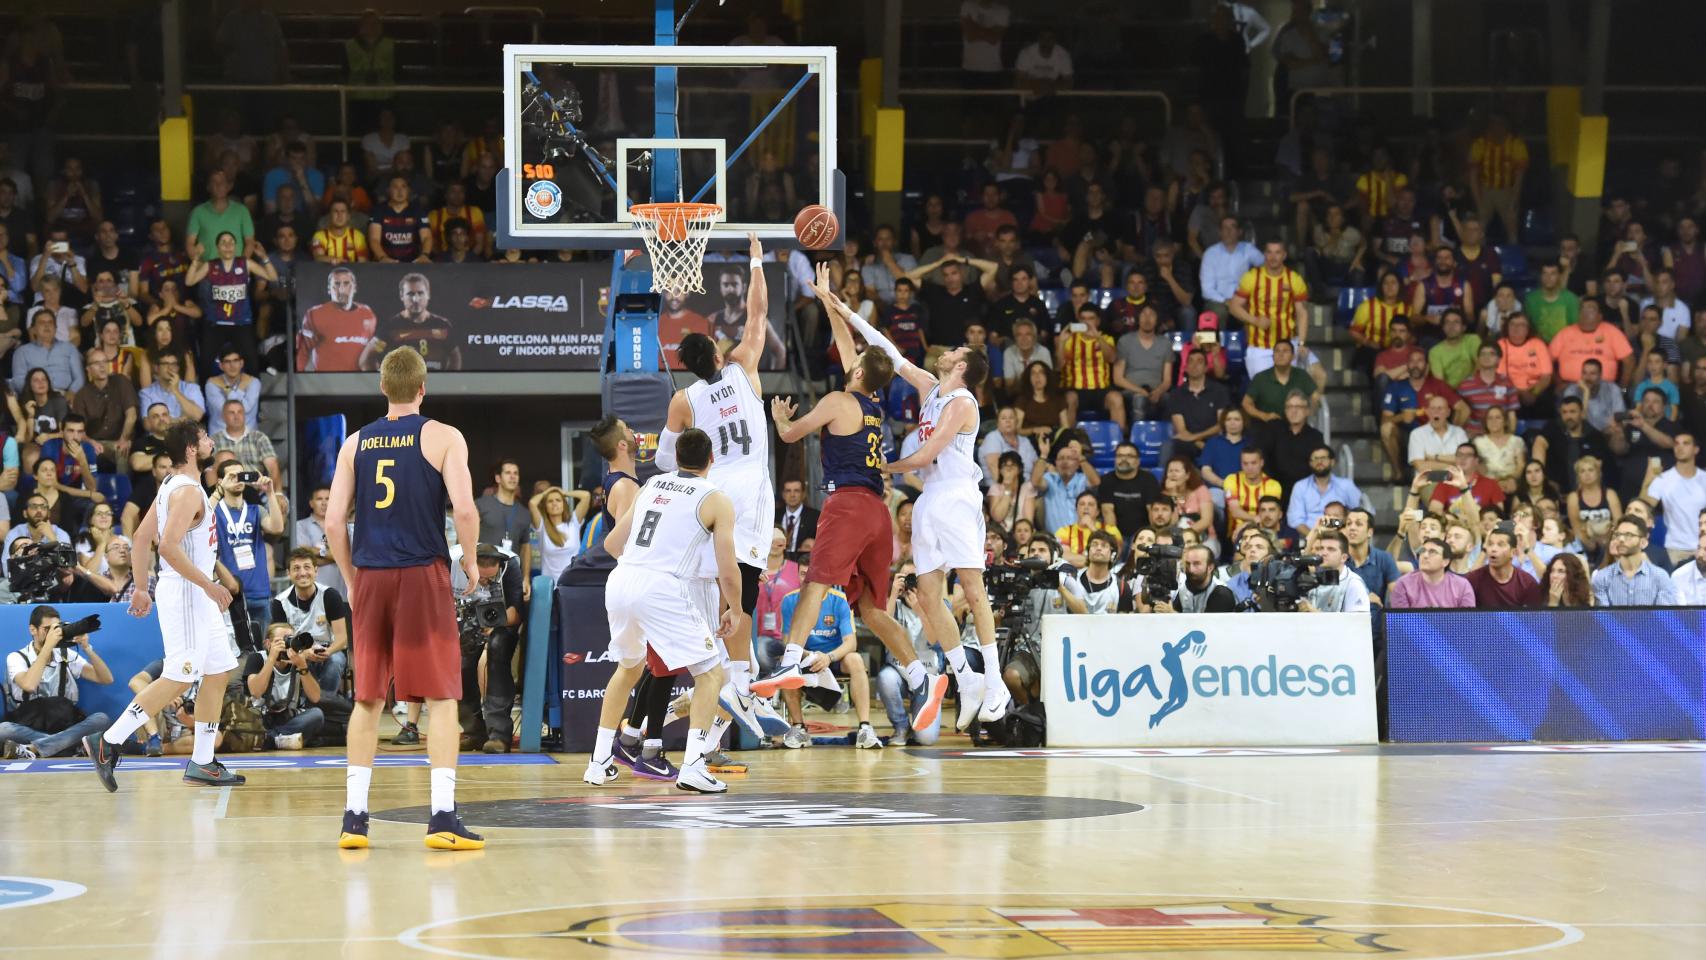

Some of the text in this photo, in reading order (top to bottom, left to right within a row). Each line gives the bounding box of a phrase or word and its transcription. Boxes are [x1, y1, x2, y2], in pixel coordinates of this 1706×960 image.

[223, 303, 232, 317] 4
[491, 296, 568, 308] LASSA
[419, 339, 428, 356] 8
[468, 335, 481, 344] FC
[484, 334, 549, 344] BARCELONA
[551, 334, 578, 343] MAIN
[499, 346, 600, 355] OF INDOOR SPORTS
[632, 327, 642, 369] MONDO
[361, 434, 414, 451] DOELLMAN
[719, 420, 752, 455] 14
[375, 459, 395, 509] 5
[636, 510, 662, 547] 8
[1062, 636, 1356, 717] liga endesa
[562, 690, 576, 699] FC
